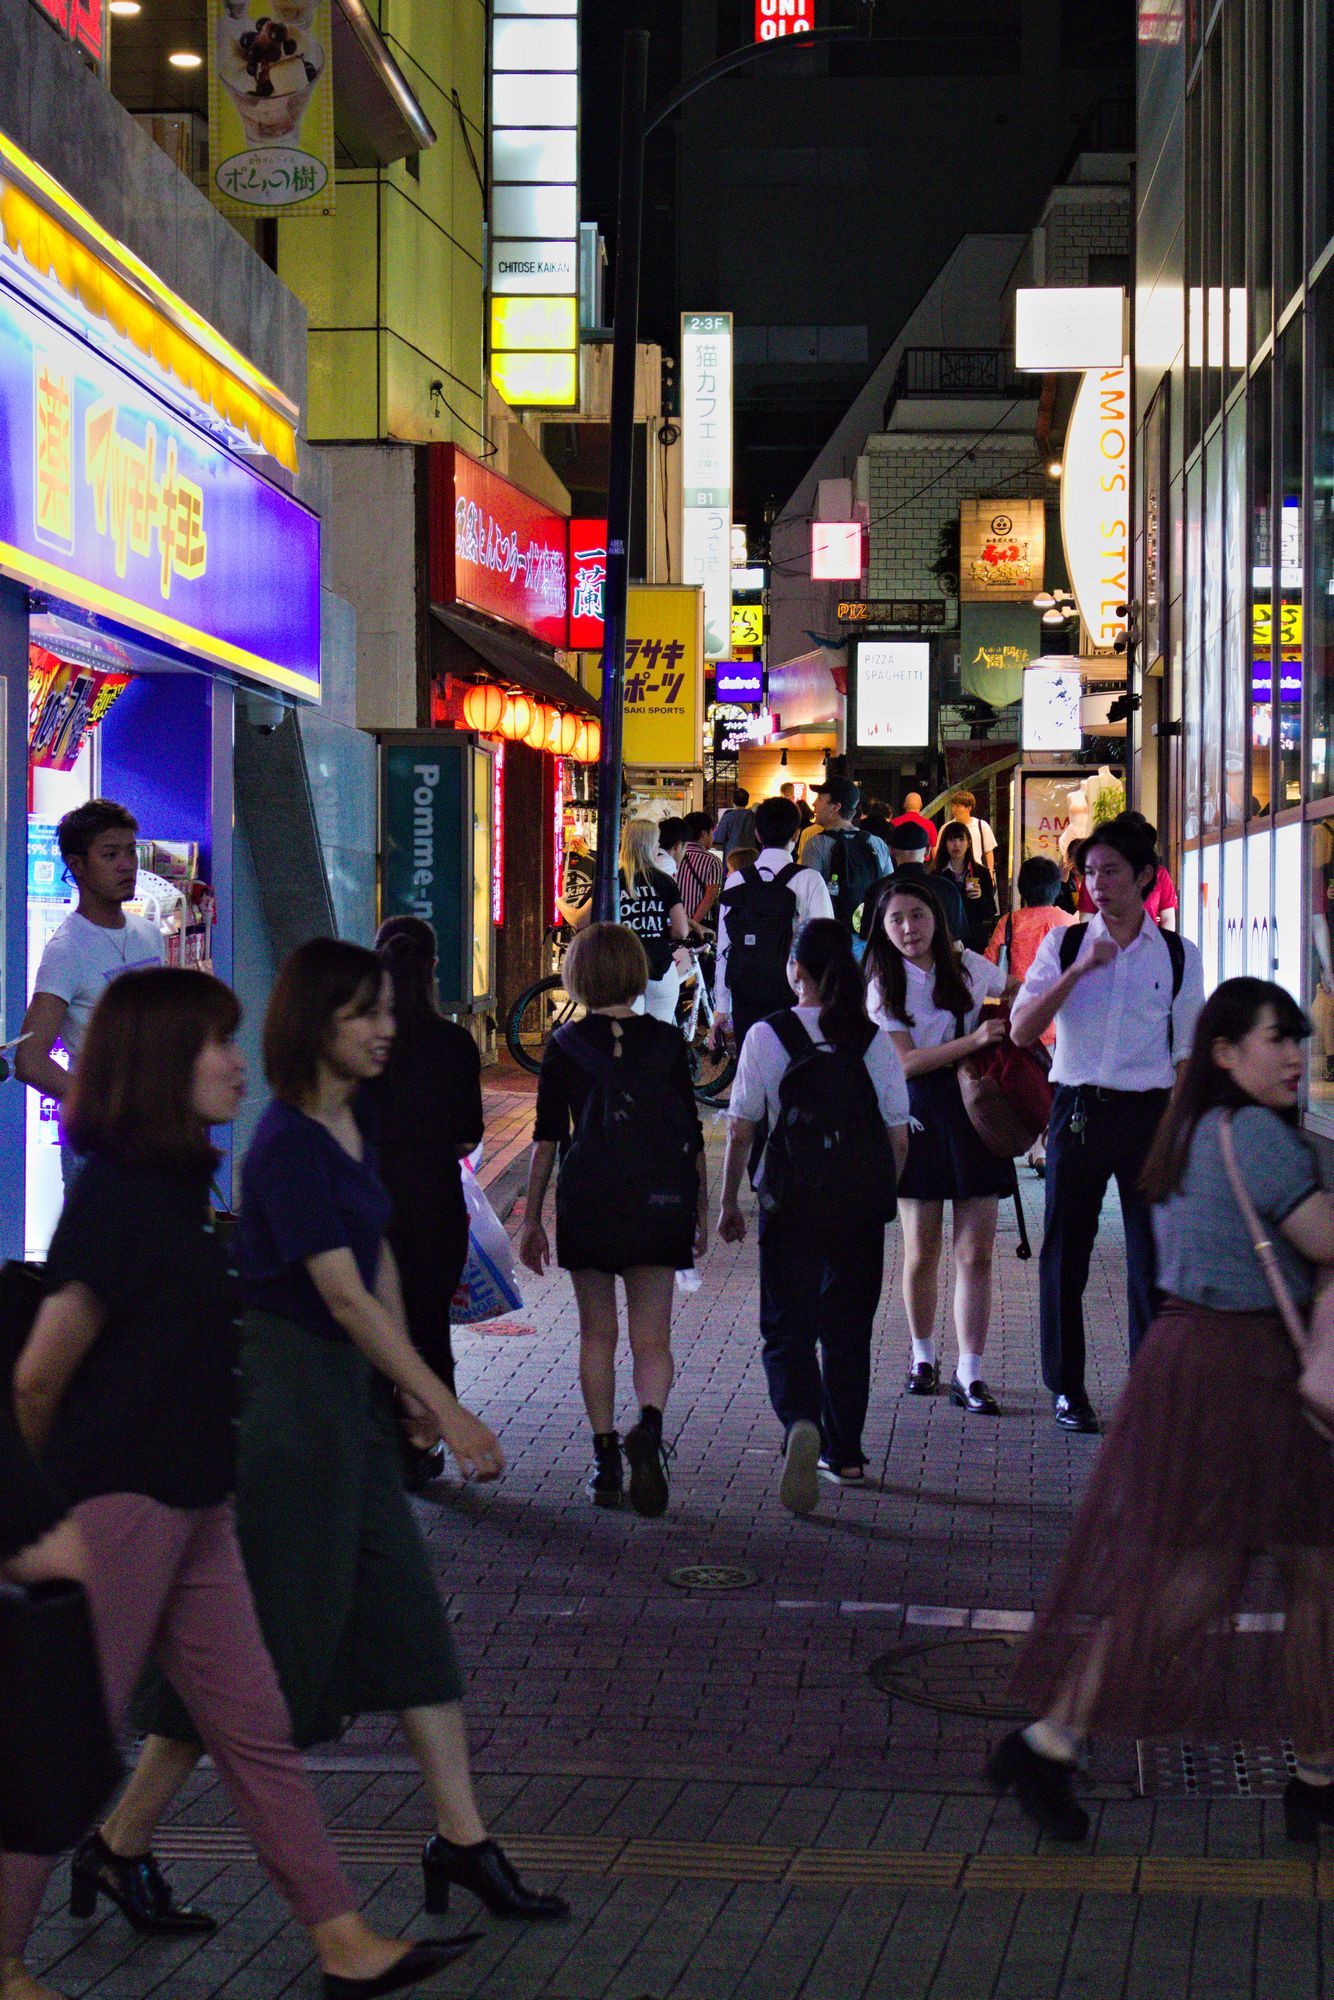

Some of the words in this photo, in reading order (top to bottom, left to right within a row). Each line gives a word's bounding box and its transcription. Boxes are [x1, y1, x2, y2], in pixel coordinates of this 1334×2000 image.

[498, 261, 535, 273] CHITOSE
[537, 262, 570, 273] KAIKAN
[695, 344, 718, 439] 猫カフェ
[697, 492, 714, 505] B1
[572, 548, 606, 622] 一蘭
[864, 654, 895, 665] PIZZA
[864, 670, 923, 681] SPAGHETTI
[648, 706, 685, 714] SPORTS
